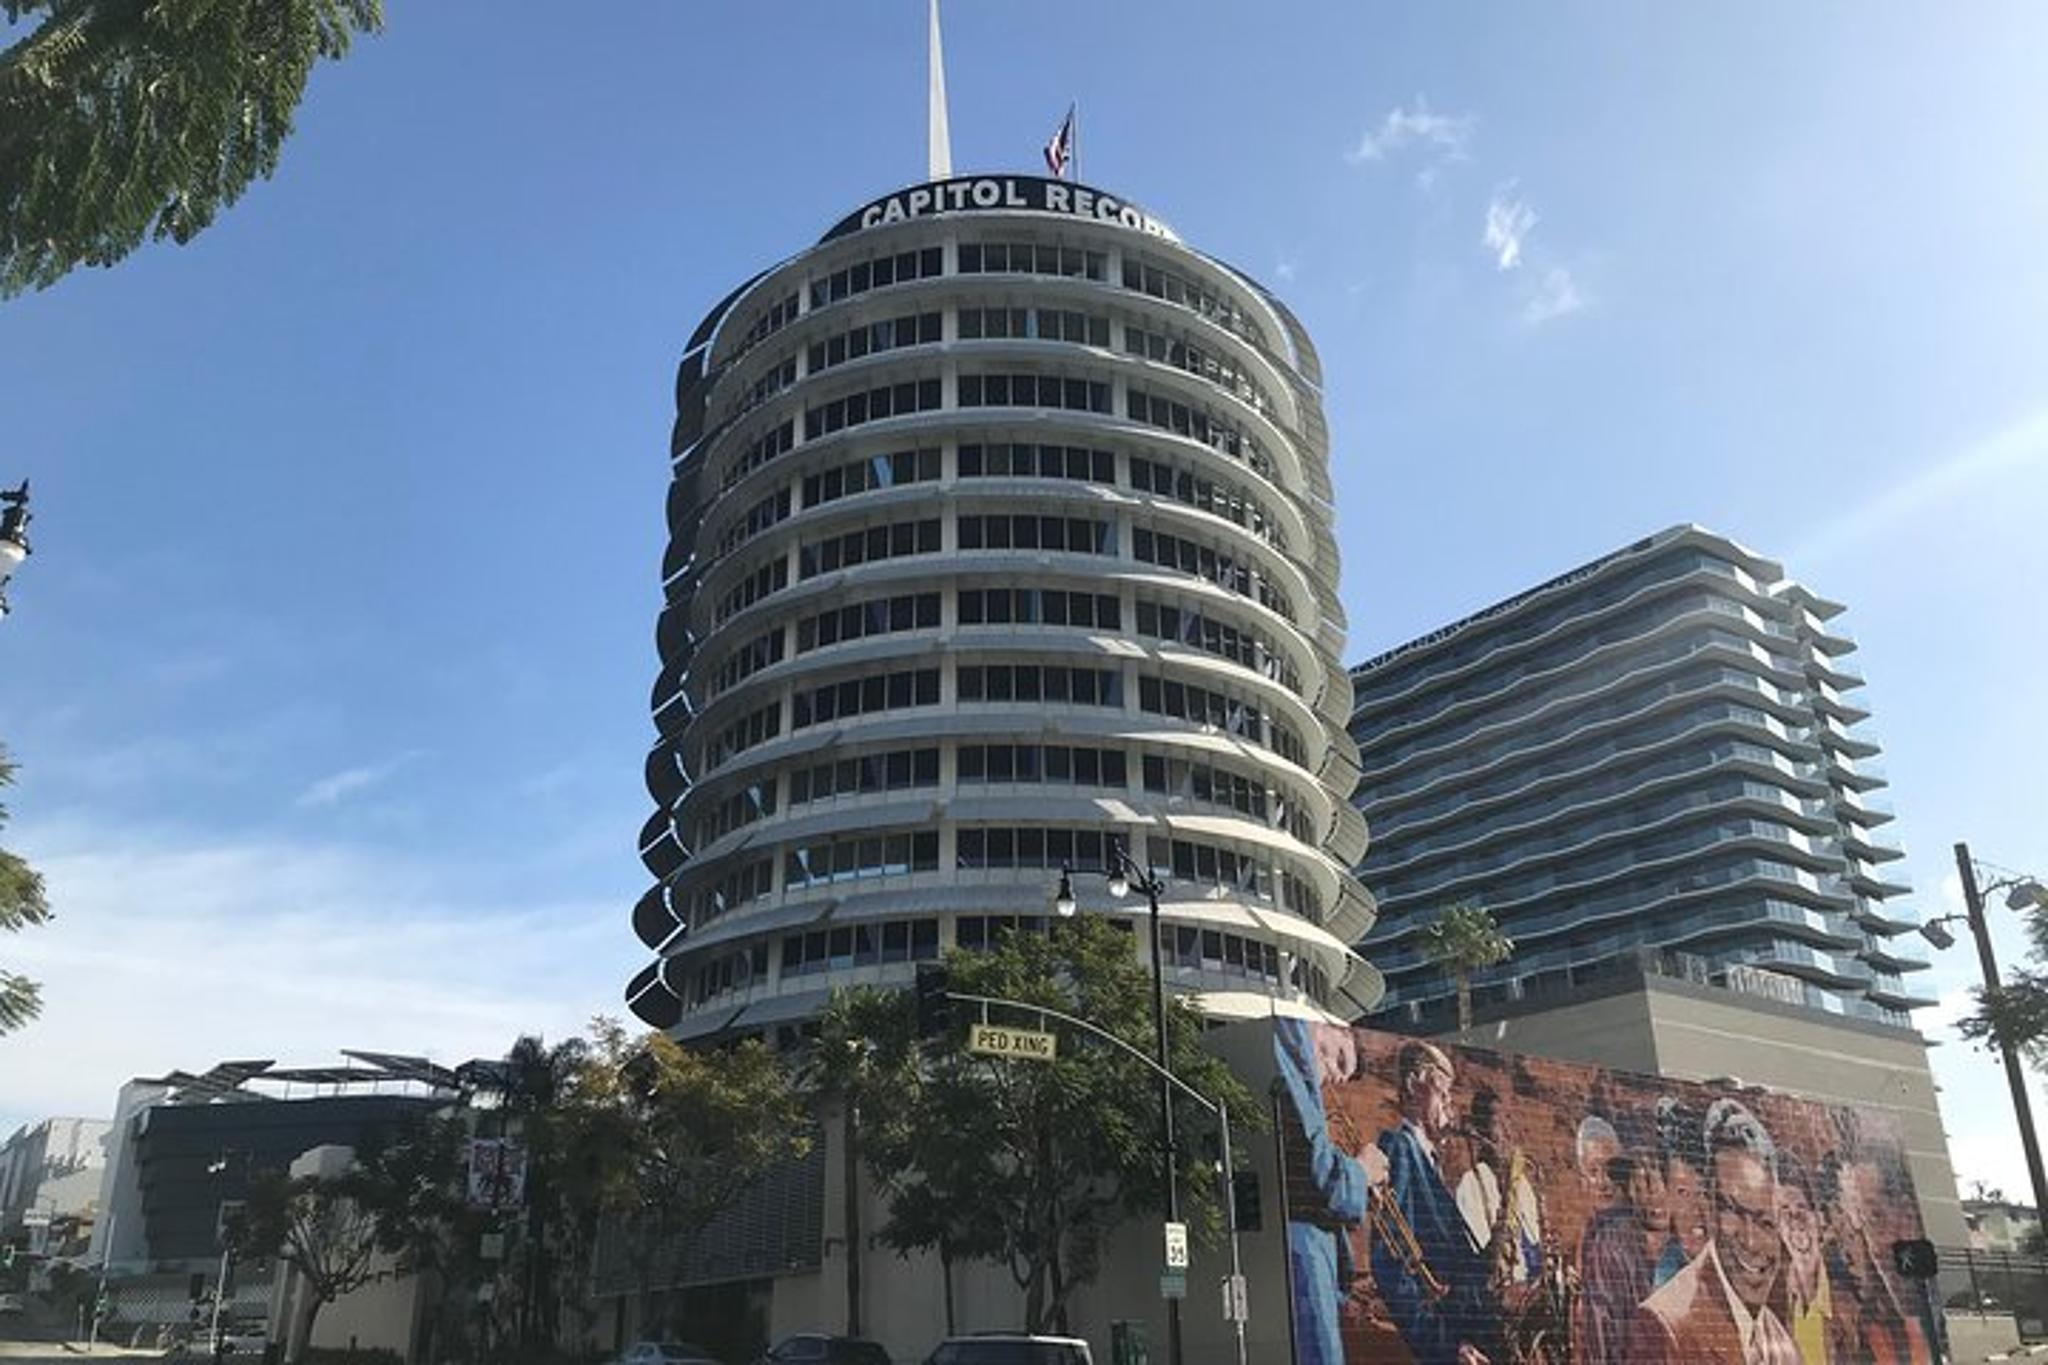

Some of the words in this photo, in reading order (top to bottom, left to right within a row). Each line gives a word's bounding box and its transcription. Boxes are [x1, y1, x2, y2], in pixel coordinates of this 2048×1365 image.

[862, 179, 1027, 229] CAPITOL
[978, 1030, 1007, 1050] PED
[1012, 1035, 1048, 1055] XING
